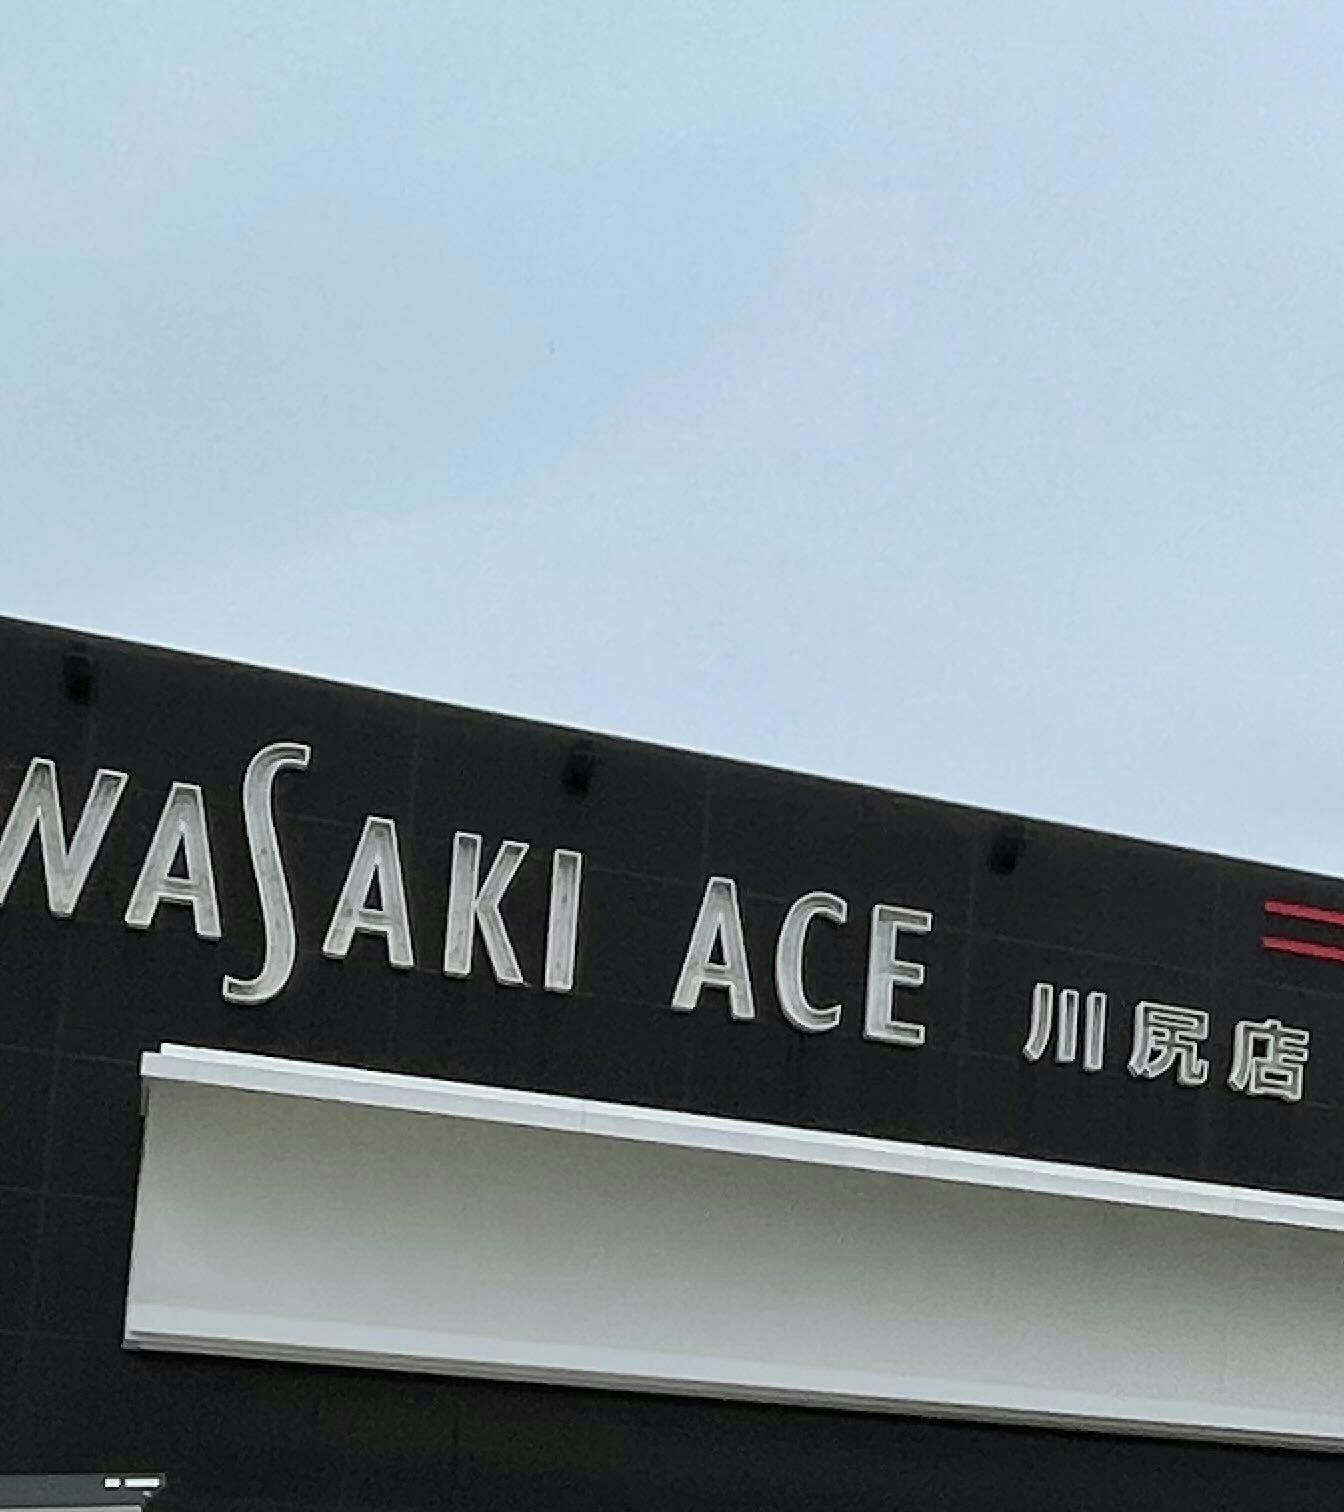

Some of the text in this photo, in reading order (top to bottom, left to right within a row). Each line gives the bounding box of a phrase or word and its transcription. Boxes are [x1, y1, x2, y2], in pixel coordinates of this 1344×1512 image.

[671, 876, 934, 1045] ACE
[1022, 981, 1311, 1102] 川尻店
